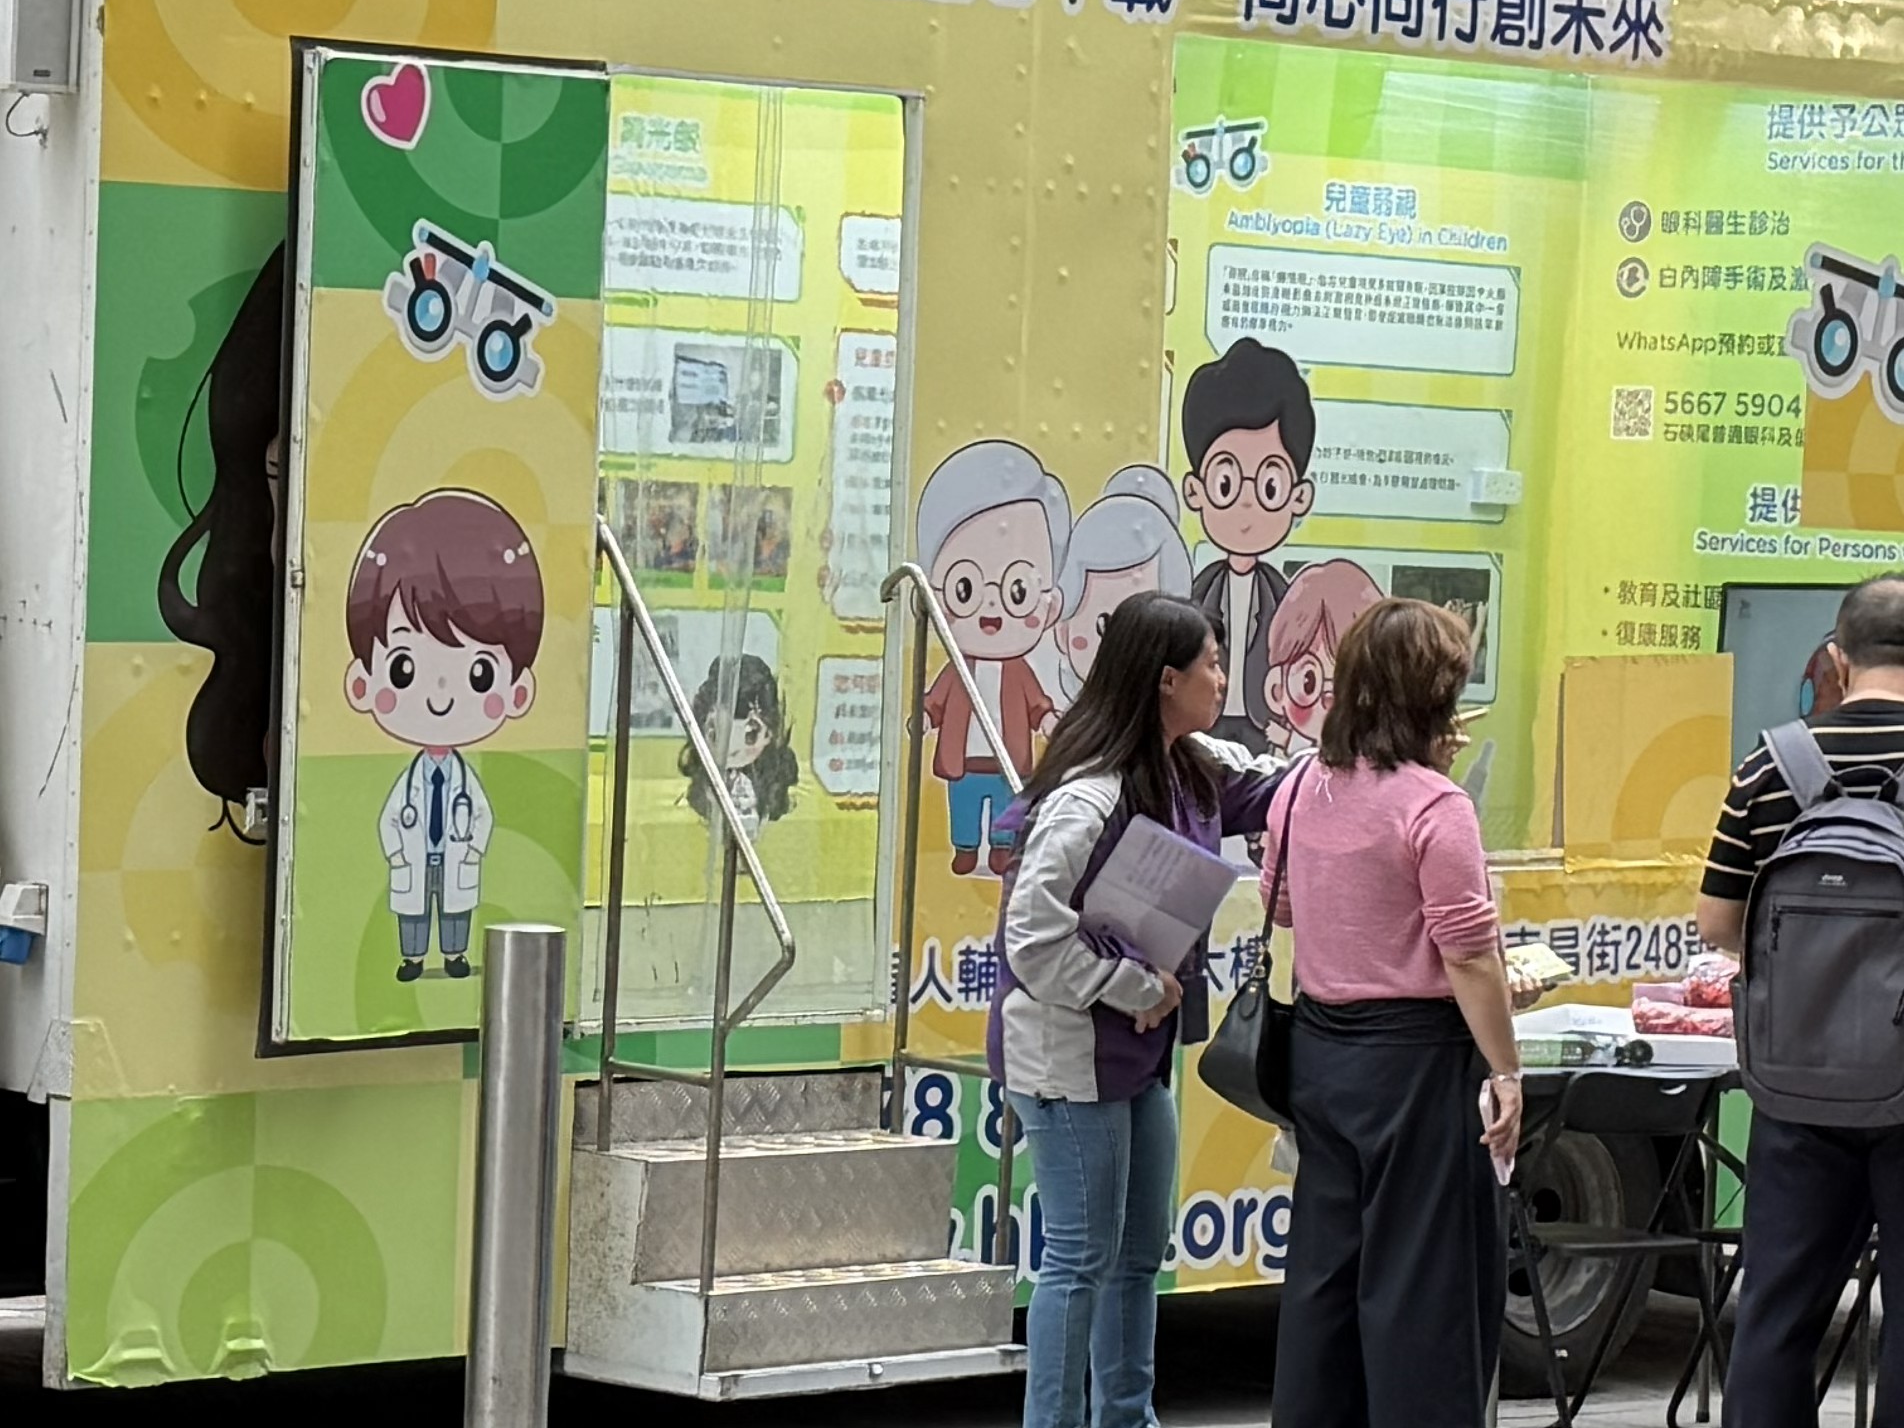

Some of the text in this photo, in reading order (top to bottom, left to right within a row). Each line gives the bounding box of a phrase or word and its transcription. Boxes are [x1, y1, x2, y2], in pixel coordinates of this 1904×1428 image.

[1768, 151, 1849, 171] Services
[1857, 151, 1885, 171] for
[1324, 181, 1417, 220] 兒童弱視
[1227, 211, 1508, 252] Amblyopia (Lazy Eye) in Children
[1660, 210, 1791, 237] 眼科醫生診治
[1663, 390, 1803, 419] 5667 5904
[1696, 531, 1778, 556] Services
[1784, 533, 1812, 557] for
[1818, 537, 1897, 561] Persons
[1615, 619, 1702, 650] 復康服務
